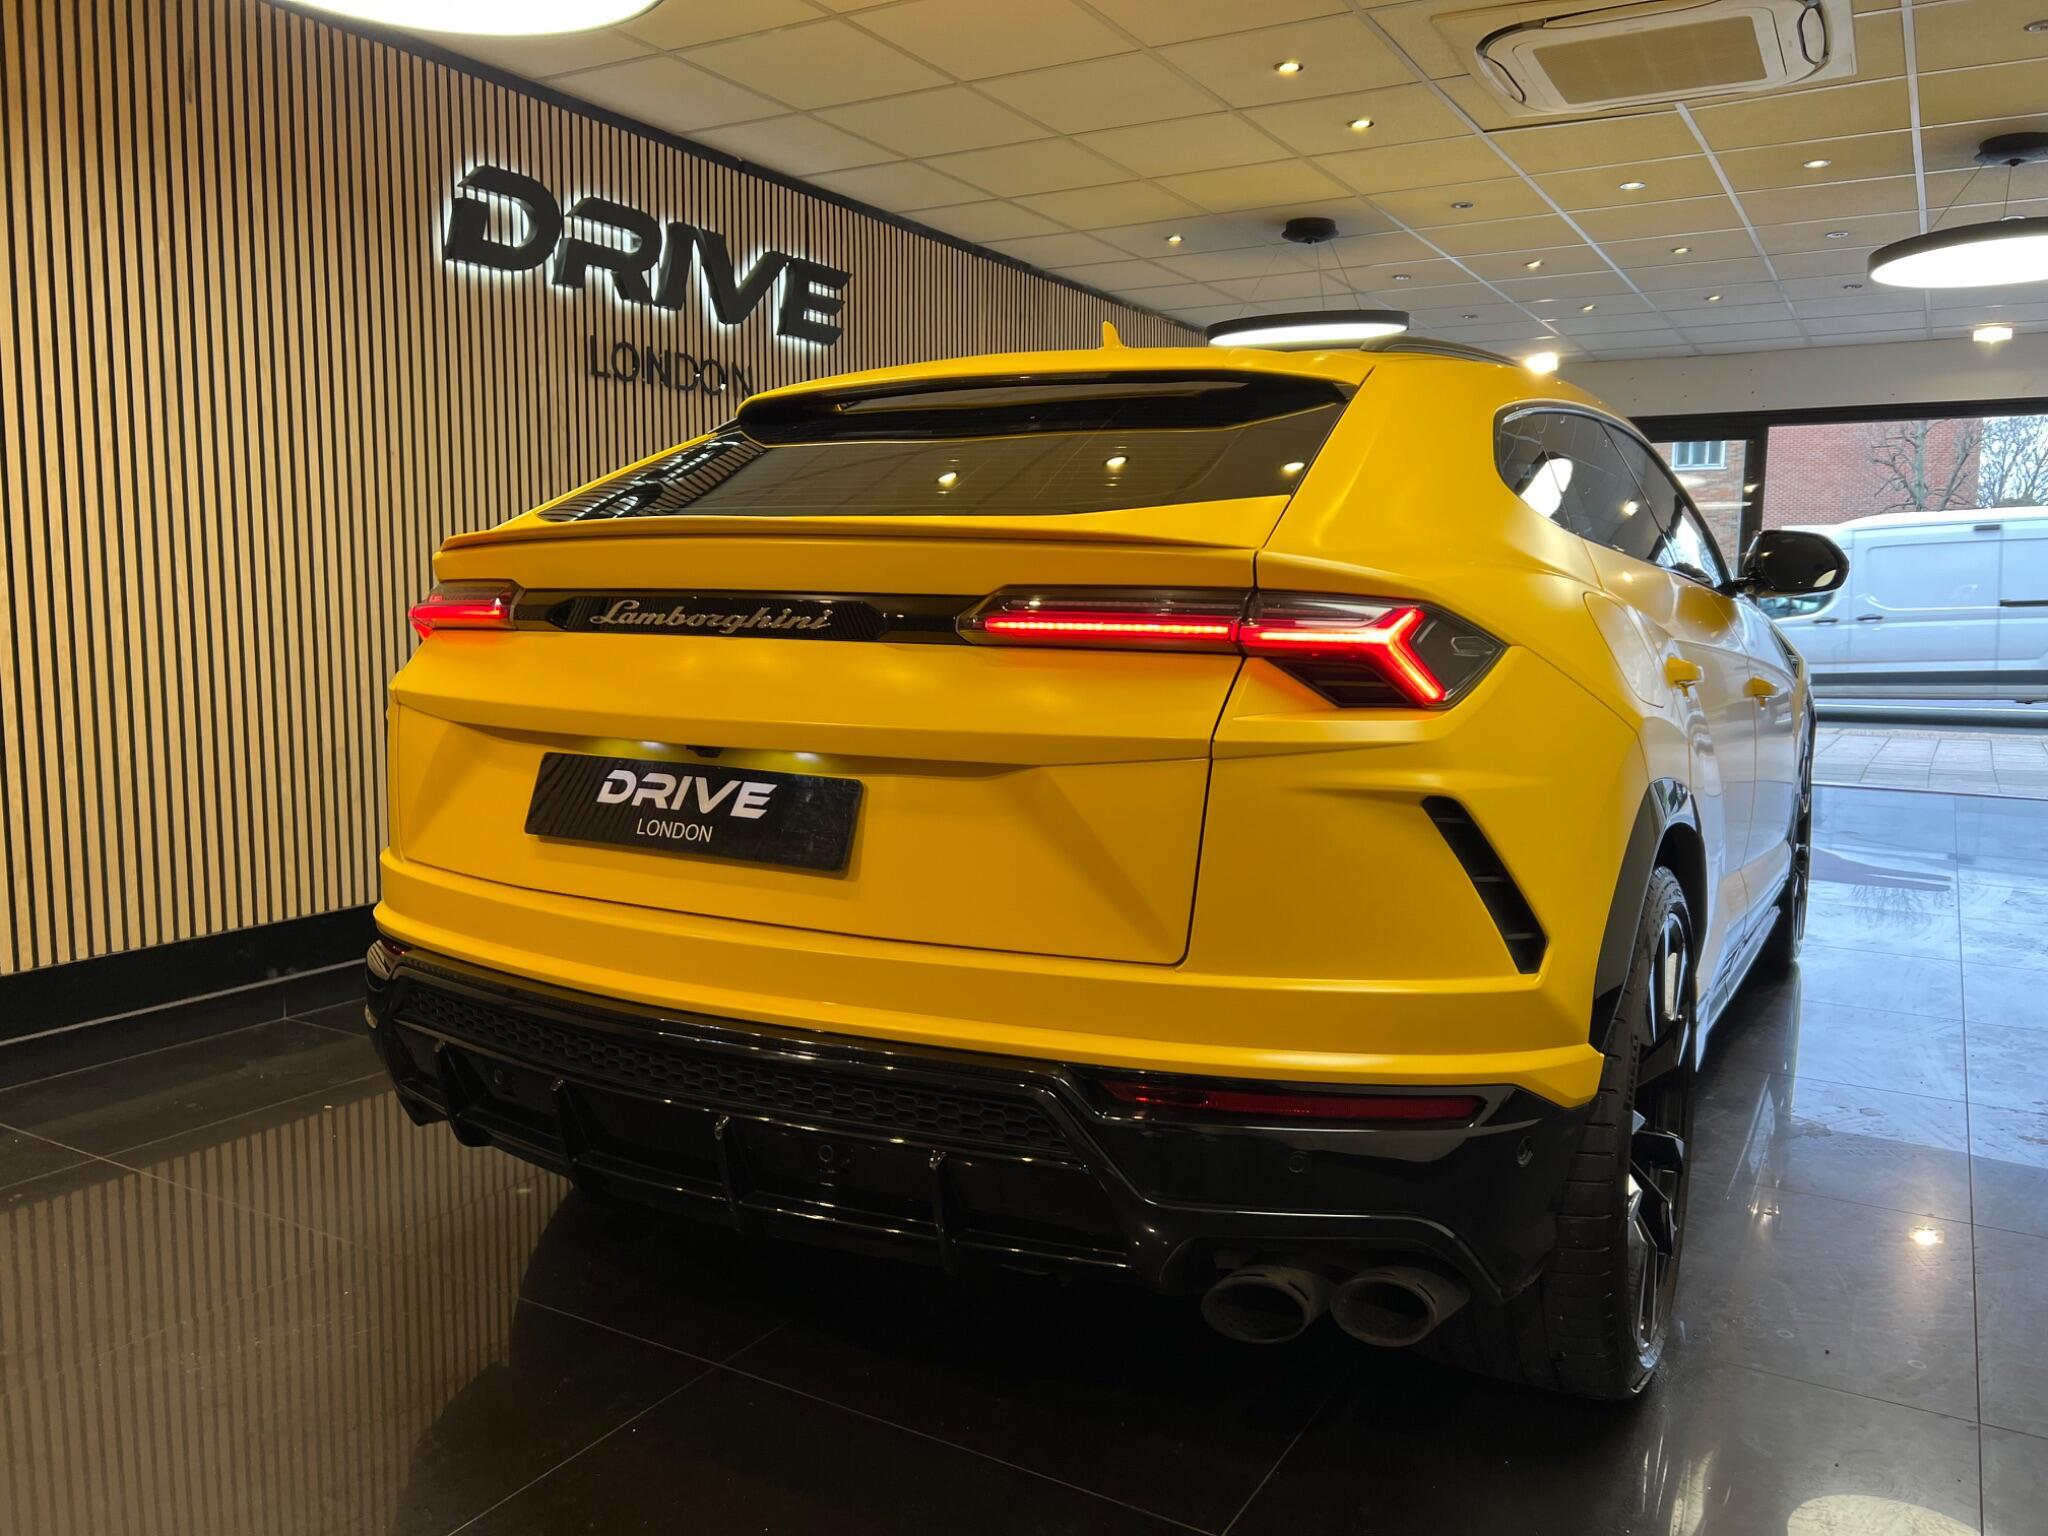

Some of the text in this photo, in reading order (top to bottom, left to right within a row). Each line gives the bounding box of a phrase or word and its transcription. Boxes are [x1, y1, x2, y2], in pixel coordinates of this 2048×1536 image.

[445, 165, 853, 346] DRIVE
[589, 335, 753, 397] LONDON
[590, 600, 832, 634] Lamborghini
[597, 769, 777, 819] DRIVE
[636, 818, 713, 843] LONDON
